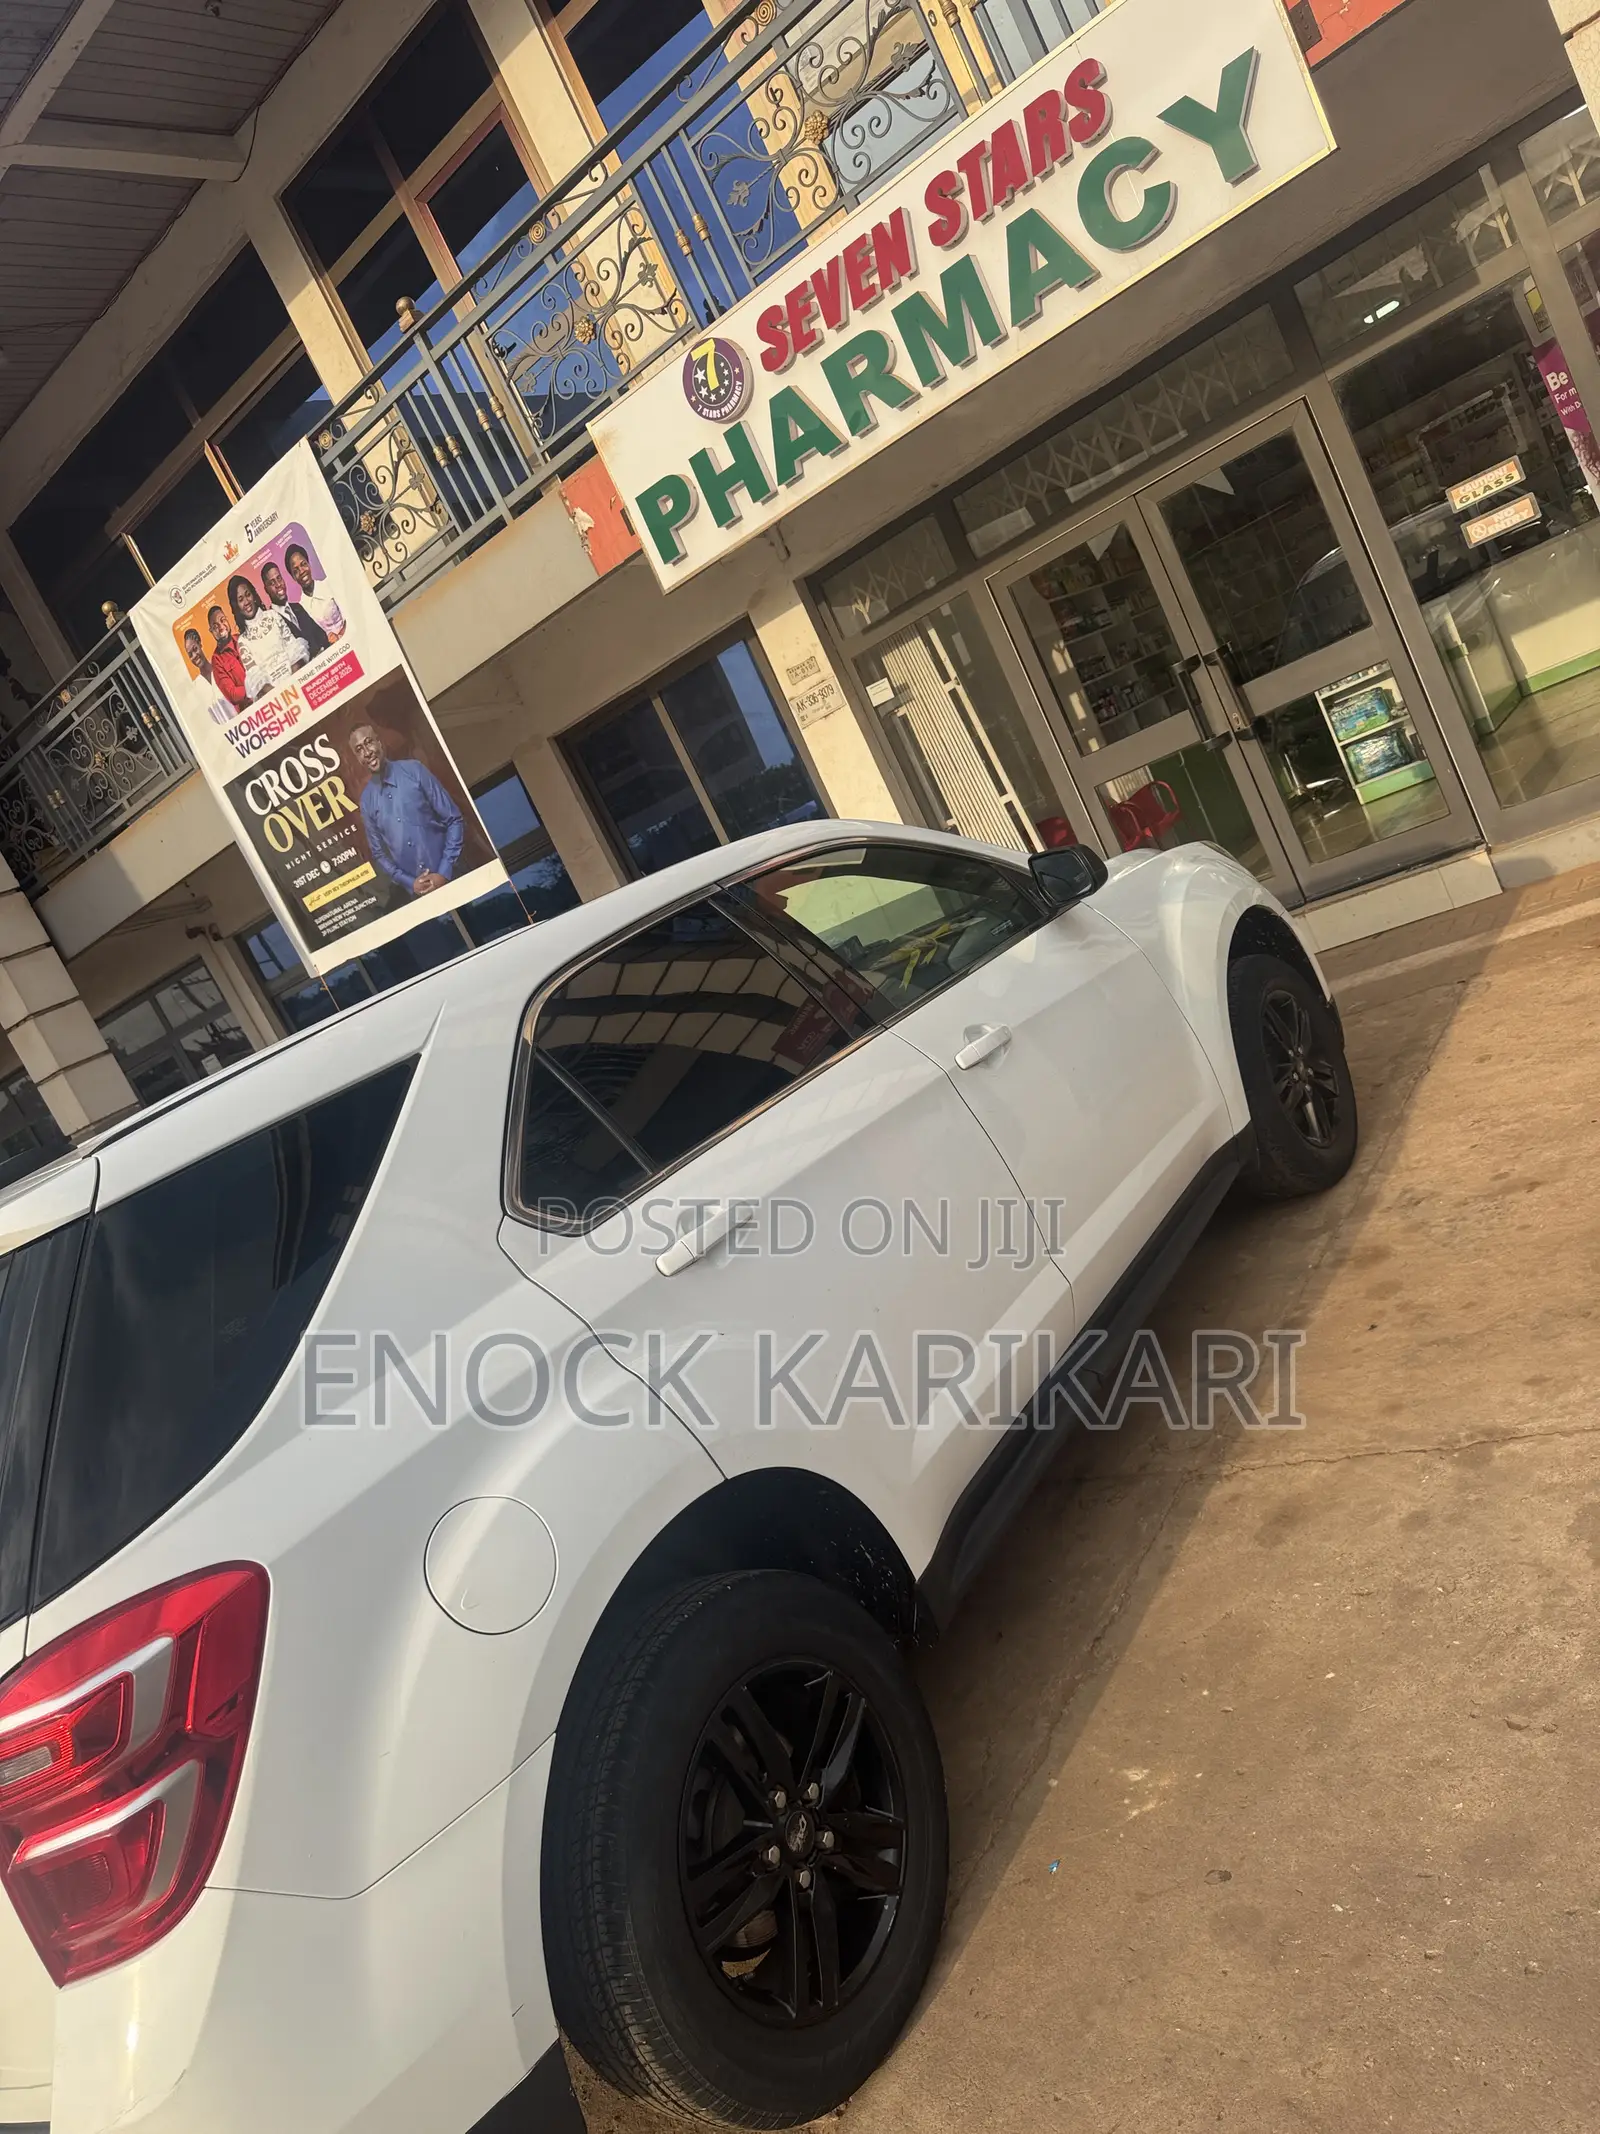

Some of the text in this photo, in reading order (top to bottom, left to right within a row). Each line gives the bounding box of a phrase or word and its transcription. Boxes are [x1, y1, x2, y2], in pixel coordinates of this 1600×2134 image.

[755, 57, 1111, 373] SEVEN STARS
[635, 45, 1260, 566] PHARMACY
[690, 338, 720, 391] 7
[1546, 370, 1570, 392] Be
[702, 407, 722, 419] STARS
[720, 380, 743, 417] PHARMACY
[1554, 390, 1569, 404] For
[1560, 405, 1575, 417] With
[1459, 472, 1515, 504] GLASS
[250, 514, 263, 528] YEARS
[253, 511, 279, 538] ANNIVERSARY
[1494, 507, 1516, 524] NO
[244, 523, 254, 544] 5
[315, 662, 328, 675] TIME
[327, 653, 341, 667] WITH
[339, 643, 351, 655] GOD
[305, 672, 330, 692] SUNDAY
[308, 665, 353, 701] DECEMBER 2025
[224, 684, 299, 746] WOMEN IN
[235, 704, 302, 759] WORSHIP
[245, 733, 341, 816] CROSS
[263, 775, 359, 853] OVER
[285, 824, 358, 870] NIGHT SERVICE
[331, 847, 358, 867] 7:00PM
[293, 868, 321, 889] 31ST DEC
[343, 898, 359, 910] ARENA
[355, 896, 377, 912] JUNCTION
[338, 915, 357, 928] STATION
